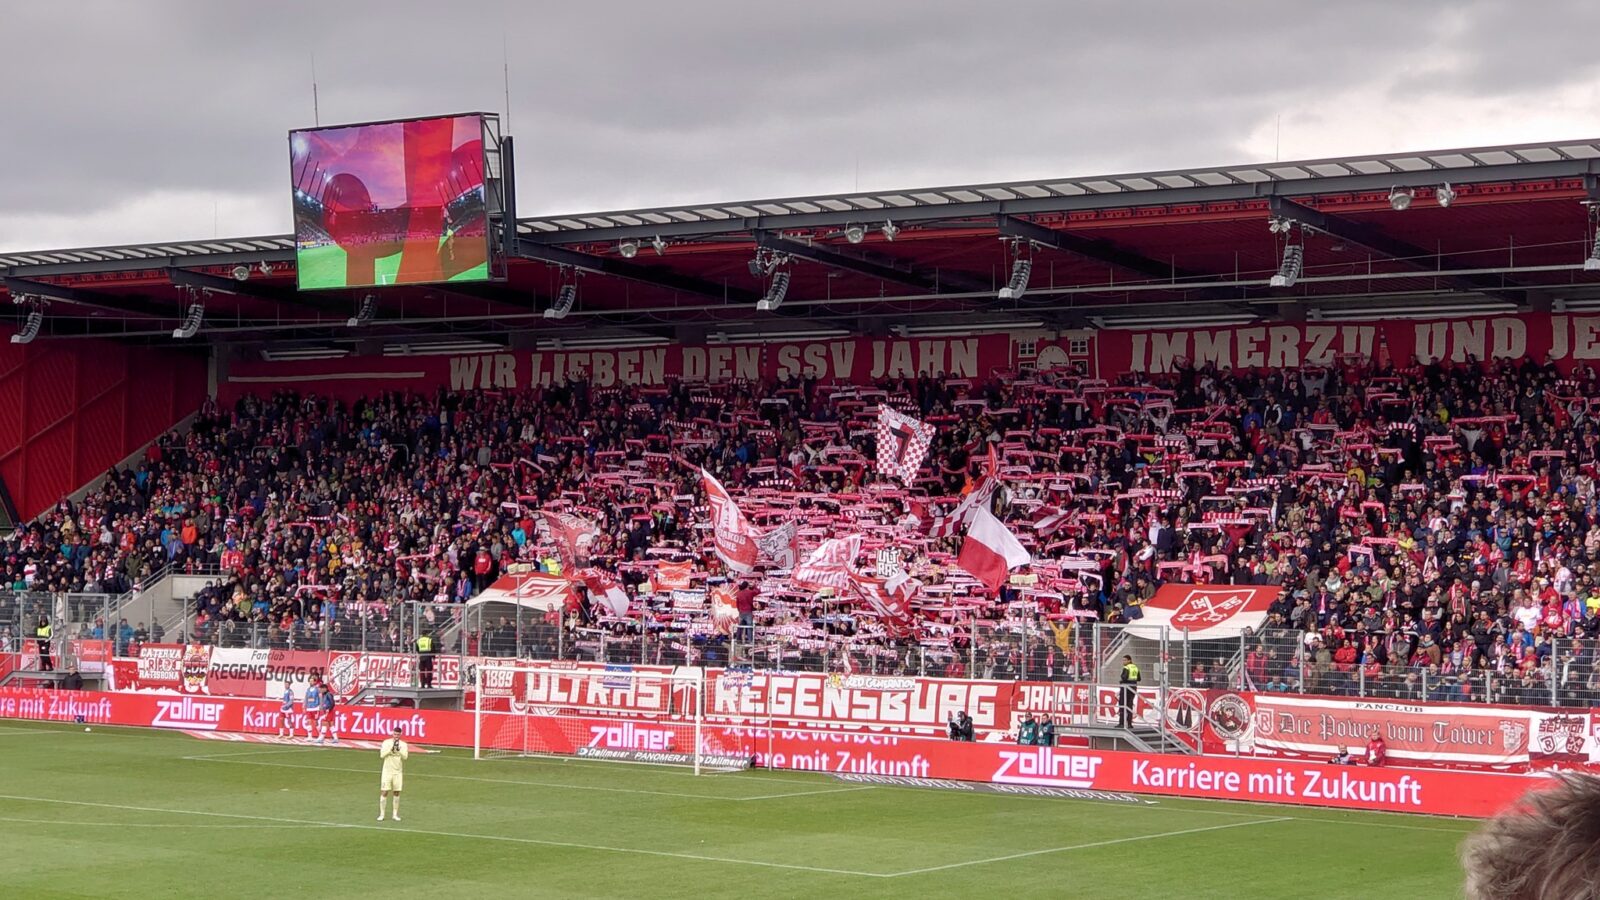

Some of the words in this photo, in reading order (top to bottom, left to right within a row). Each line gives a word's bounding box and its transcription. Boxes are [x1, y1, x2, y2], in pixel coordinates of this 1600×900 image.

[1131, 325, 1375, 373] IMMERZU
[1413, 318, 1527, 365] UND
[450, 355, 516, 390] WIR
[531, 348, 666, 389] LIEBEN
[682, 346, 760, 383] DEN
[777, 341, 856, 381] SSV
[870, 339, 979, 379] JAHN
[251, 650, 285, 661] Fanclub
[210, 662, 306, 683] REGENSBURG
[485, 670, 514, 687] 1889
[527, 666, 664, 709] ULTRAS
[714, 675, 998, 726] REGENSBURG
[1018, 686, 1073, 711] JAHN
[19, 695, 45, 714] mit
[48, 695, 112, 718] Zukunft
[151, 697, 224, 729] zollner
[1355, 702, 1424, 713] FANCLUB
[350, 711, 425, 737] Zukunft
[1279, 712, 1311, 734] Die
[1320, 713, 1380, 741] Power
[1387, 720, 1424, 743] vom
[1432, 720, 1495, 746] Tower
[634, 751, 688, 762] PANOMERA
[792, 750, 830, 771] mit
[836, 752, 930, 777] Zukunft
[992, 746, 1103, 788] zollner
[1132, 759, 1240, 793] Karriere
[1248, 768, 1295, 795] mit
[1302, 769, 1422, 804] Zukunft
